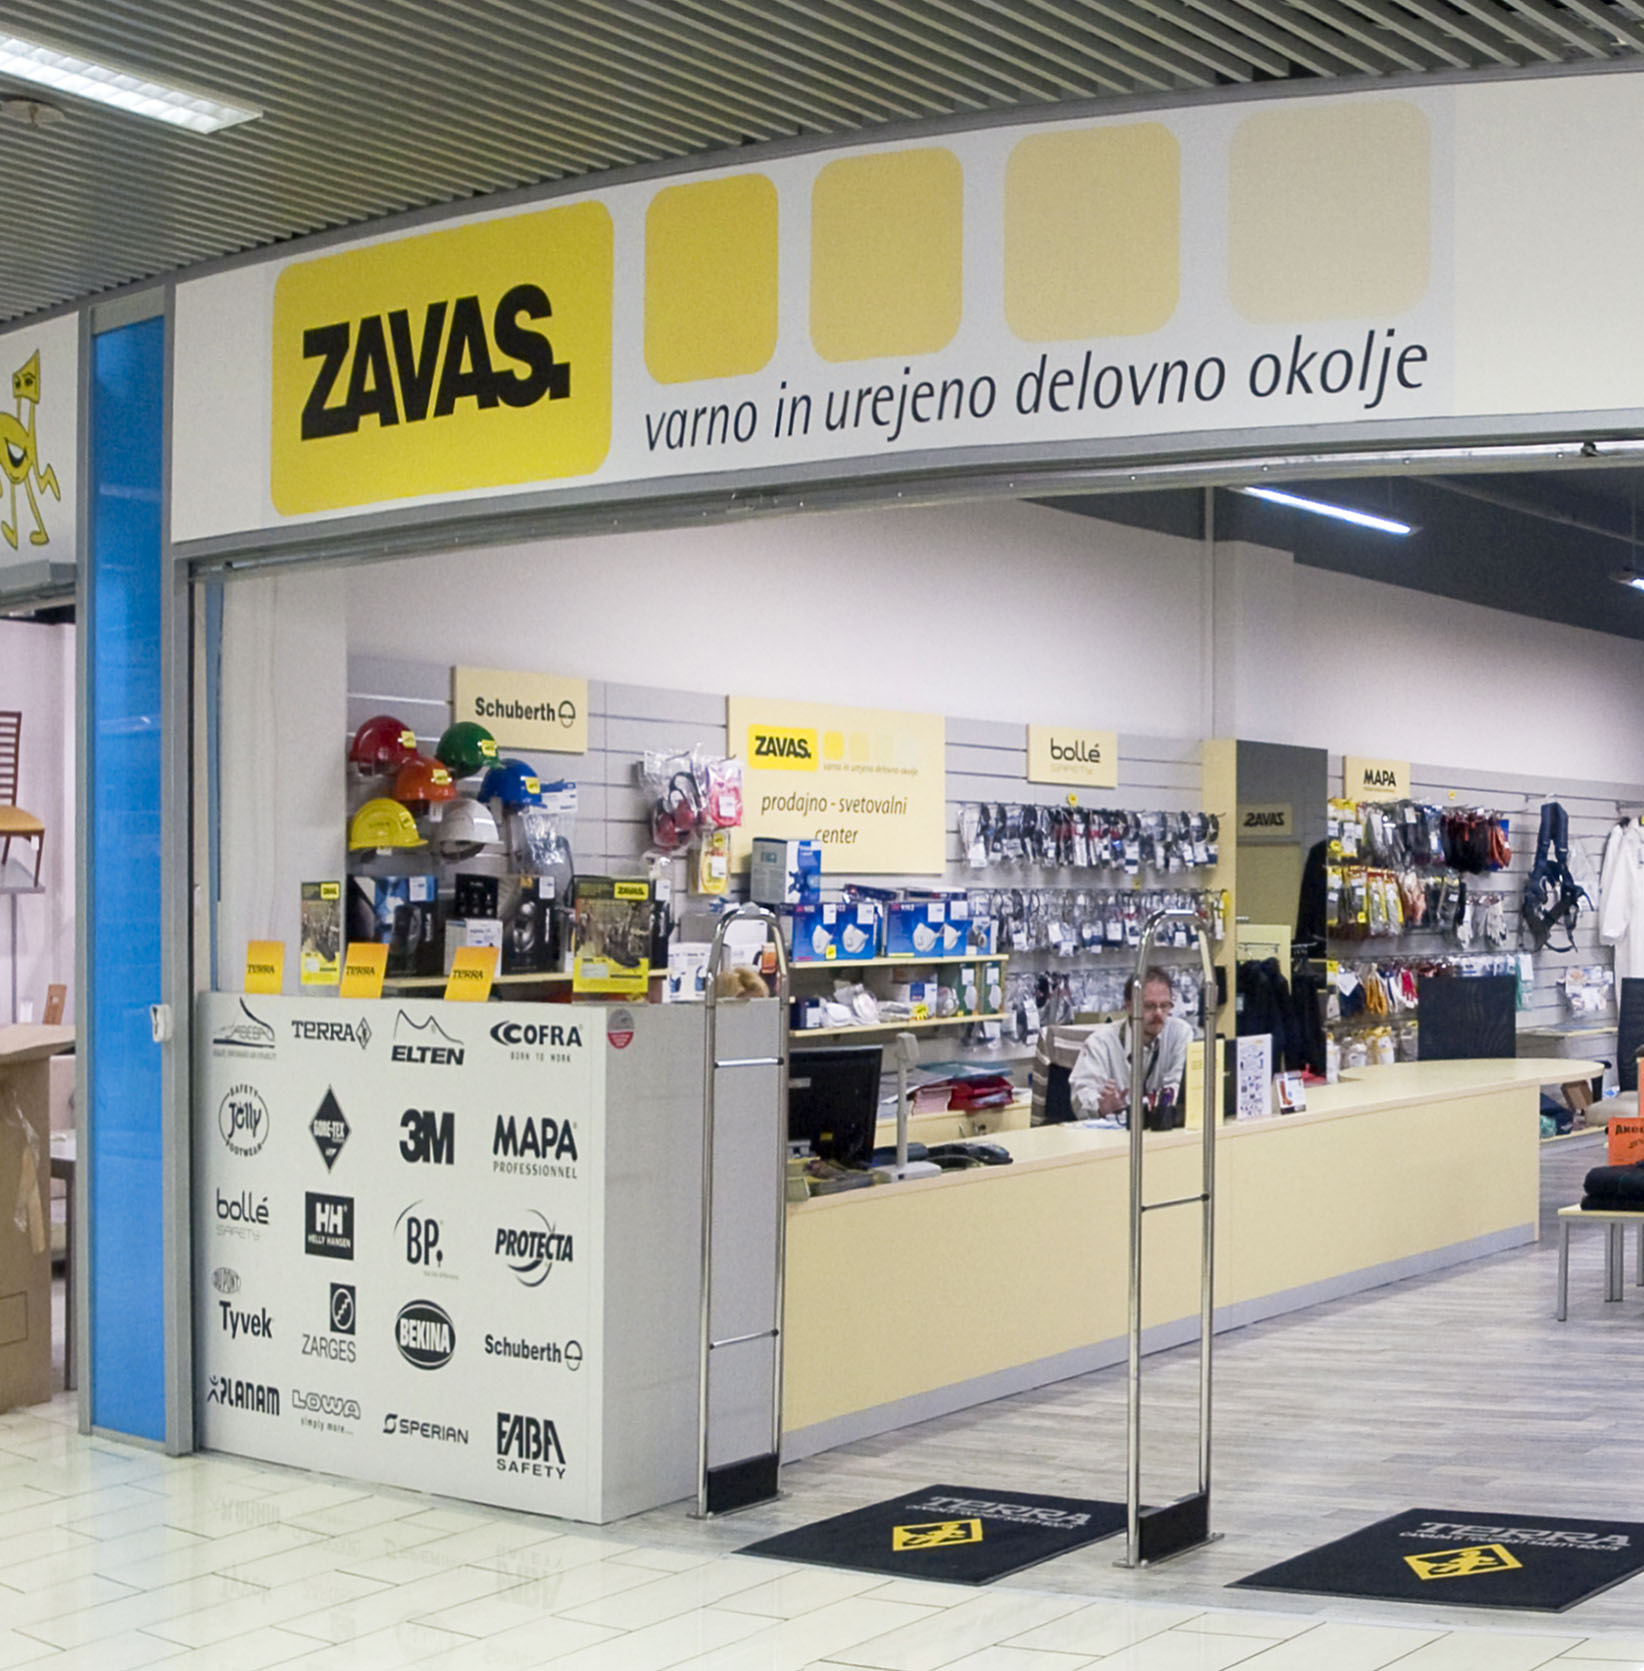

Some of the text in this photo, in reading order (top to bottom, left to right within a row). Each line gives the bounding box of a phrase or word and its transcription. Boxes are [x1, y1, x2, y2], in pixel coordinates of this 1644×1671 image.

[301, 283, 570, 442] ZAVAS.
[645, 328, 1428, 452] varno in urejeno delovno okolje
[475, 697, 556, 722] Schuberth
[1050, 737, 1101, 764] bollé
[1363, 769, 1397, 787] MAPA
[761, 792, 828, 817] prodajno
[838, 795, 908, 815] svetovalni
[815, 828, 859, 844] center
[291, 1020, 356, 1042] TERRA
[490, 1021, 583, 1047] COFRA
[391, 1045, 465, 1066] ELTEN
[229, 1083, 259, 1099] SAFETY
[228, 1102, 262, 1139] Jolly
[225, 1139, 264, 1157] FOOTWEAR
[399, 1108, 455, 1166] 3M
[493, 1114, 578, 1162] MAPA
[493, 1161, 578, 1180] PROFESSIONNEL
[216, 1188, 269, 1225] bollé
[315, 1203, 344, 1235] HH
[307, 1234, 352, 1249] HELLY HANSEN
[495, 1228, 574, 1262] PROTECTA
[219, 1301, 273, 1340] Tyvek
[302, 1334, 357, 1364] ZARGES
[399, 1317, 450, 1354] BEKINA
[485, 1334, 562, 1363] Schuberth
[219, 1377, 281, 1417] PLANAM
[291, 1389, 361, 1420] LOWA
[399, 1418, 469, 1445] SPERIAN
[497, 1412, 567, 1465] FABA
[497, 1458, 567, 1480] SAFETY
[925, 1496, 1092, 1526] TERRA
[1416, 1522, 1632, 1547] TERRA
